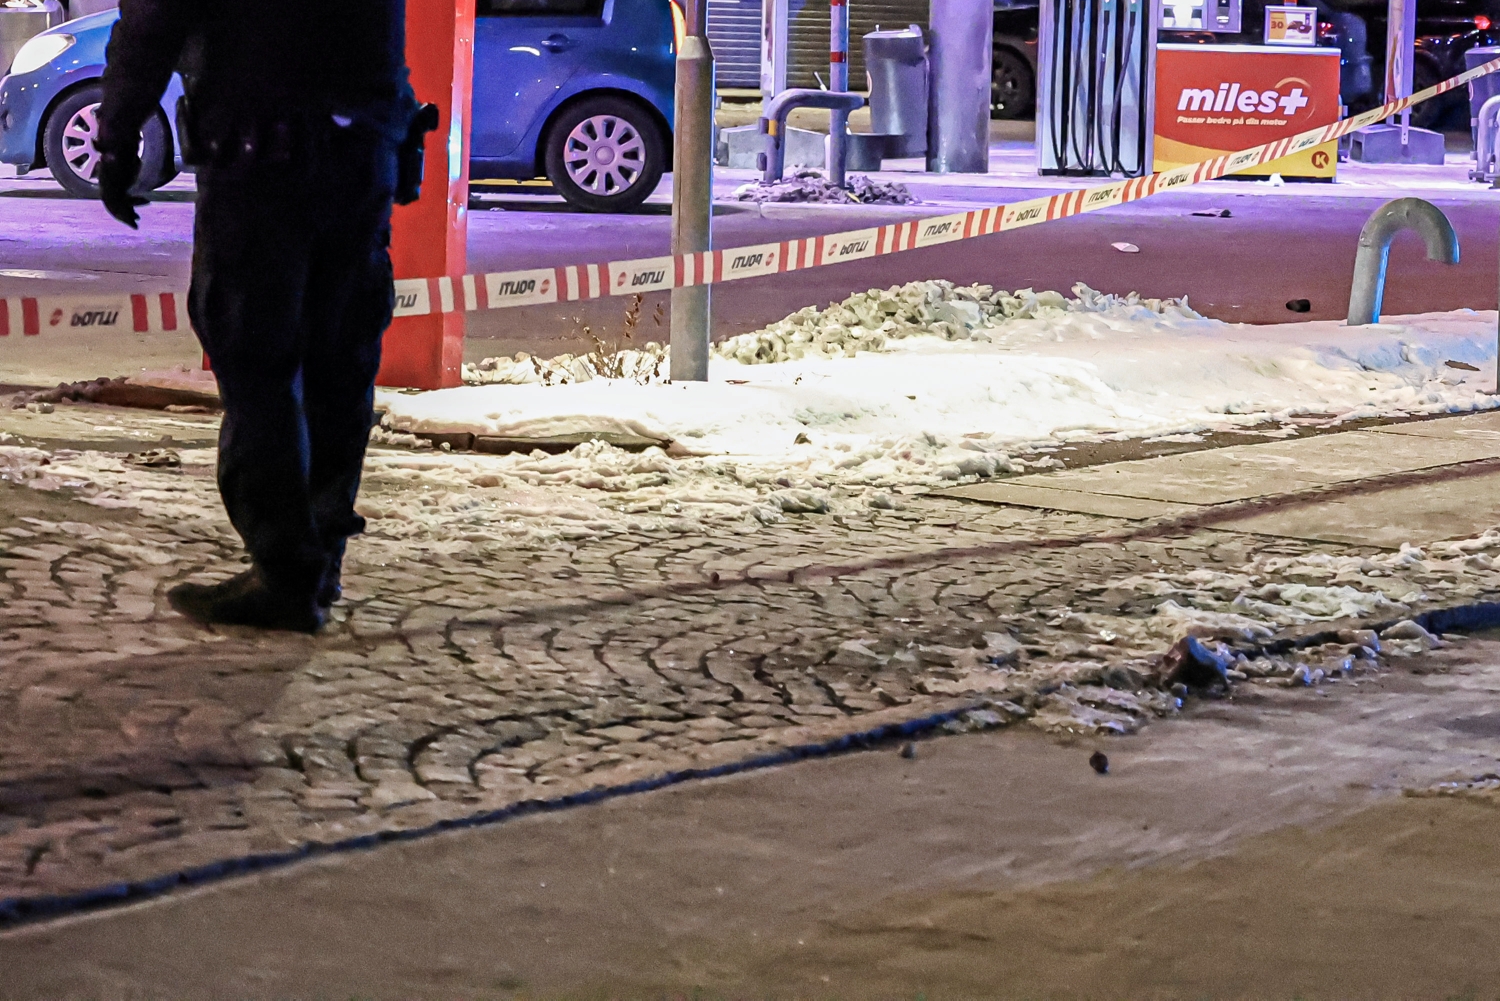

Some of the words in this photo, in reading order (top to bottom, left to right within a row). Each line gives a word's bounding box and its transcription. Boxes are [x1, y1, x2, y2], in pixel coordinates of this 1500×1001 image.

[1270, 20, 1284, 30] 30
[1177, 82, 1309, 116] miles+
[1176, 115, 1206, 124] Passer
[1206, 116, 1231, 125] bedre
[1232, 116, 1244, 126] på
[1245, 117, 1260, 126] din
[1260, 118, 1288, 127] motor
